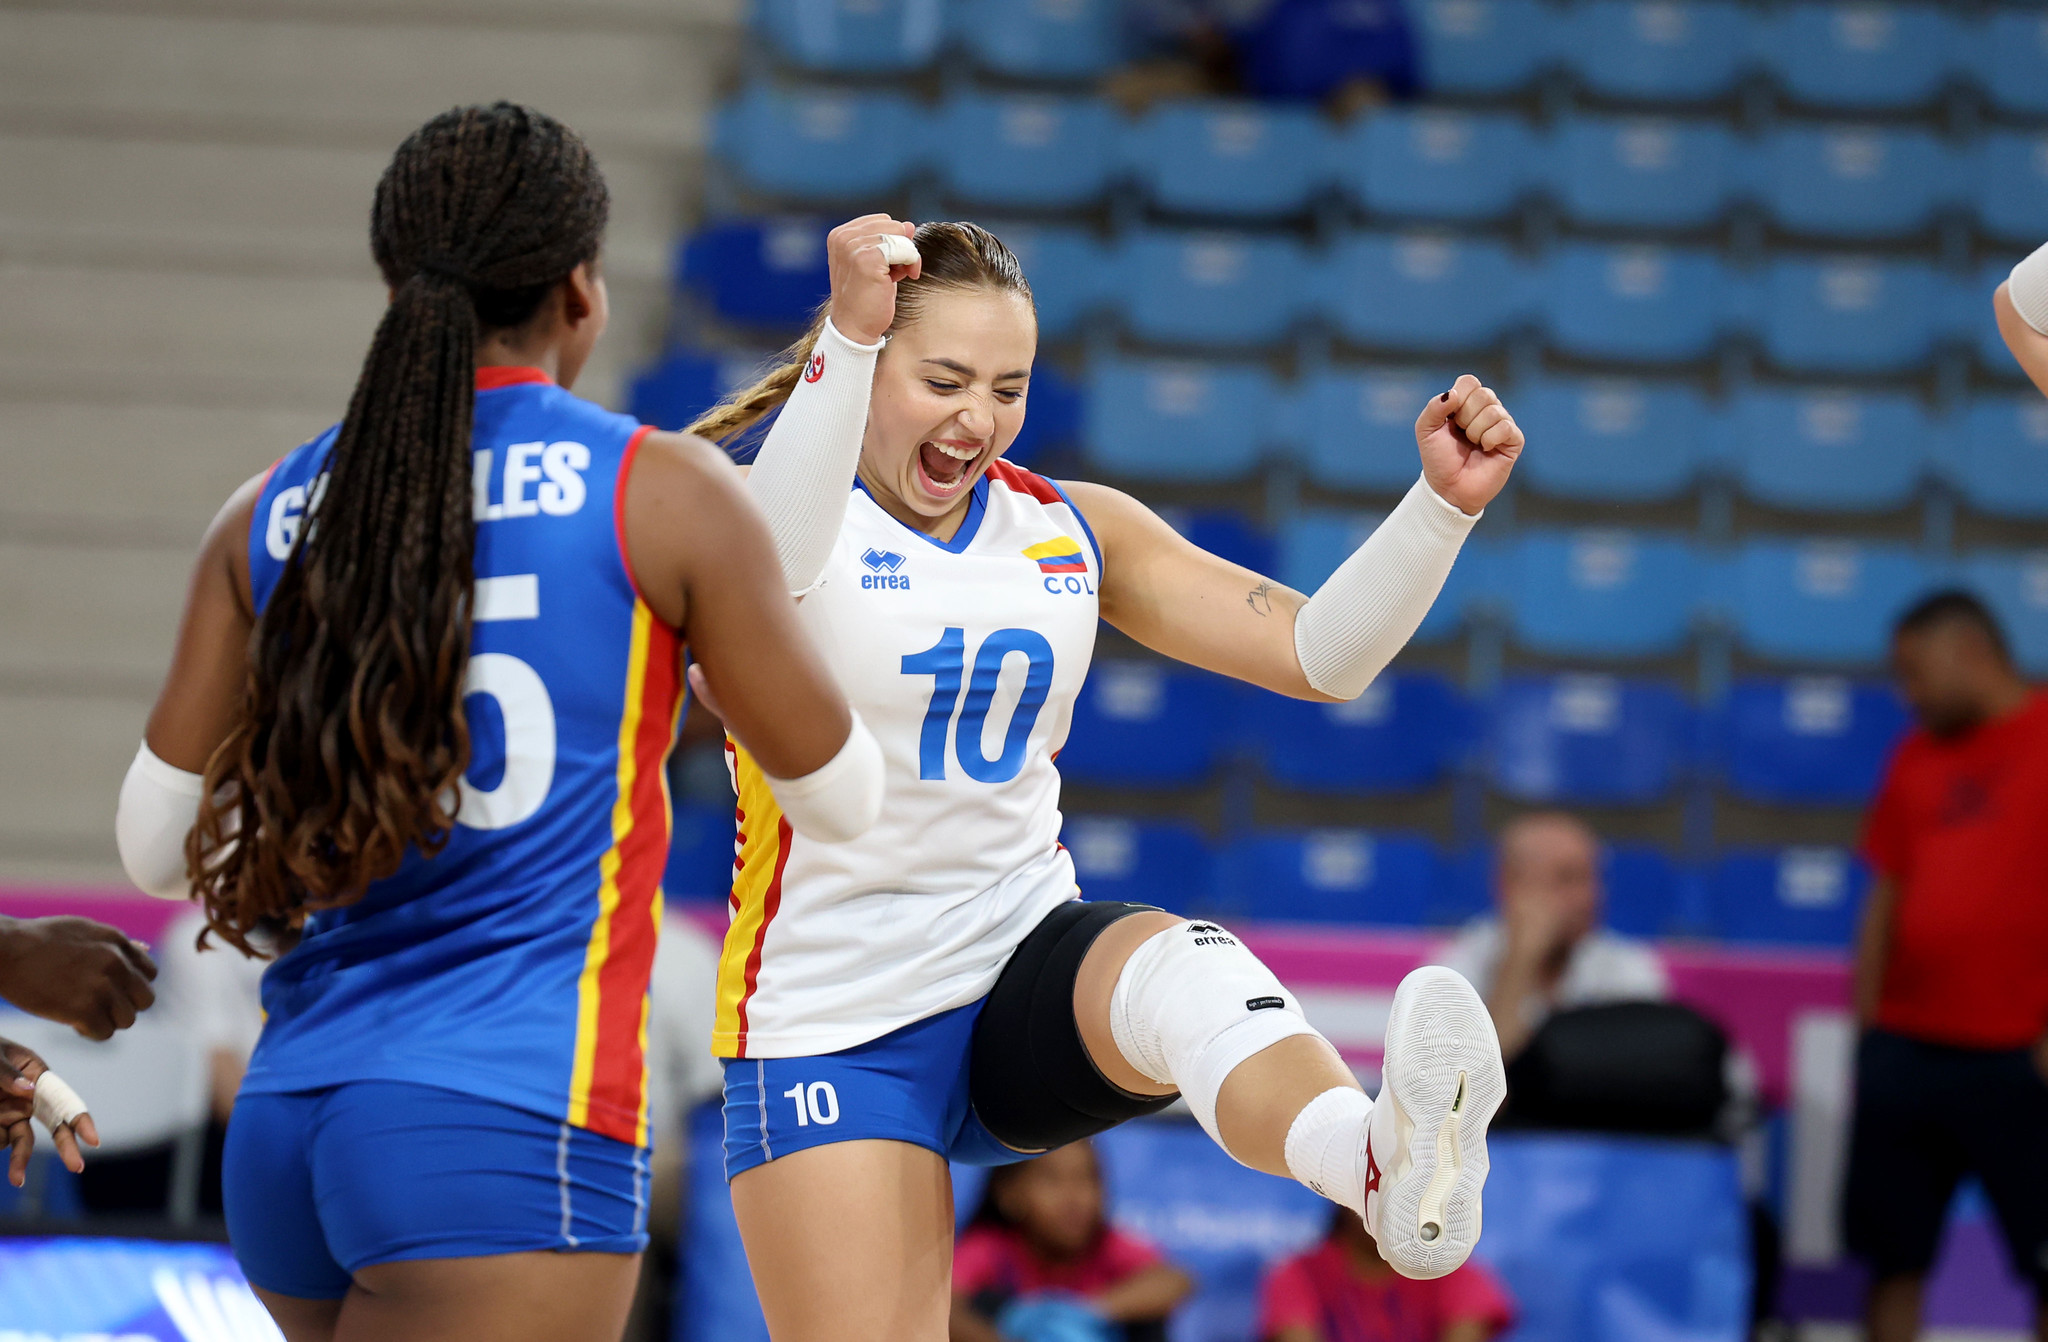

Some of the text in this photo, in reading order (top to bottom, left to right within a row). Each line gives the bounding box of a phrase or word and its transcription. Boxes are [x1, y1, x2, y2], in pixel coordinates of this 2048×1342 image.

[265, 440, 591, 561] GLES
[861, 574, 910, 590] errea
[1043, 576, 1094, 595] COL
[900, 627, 1055, 784] 10
[1194, 936, 1236, 947] errea
[783, 1081, 840, 1127] 10
